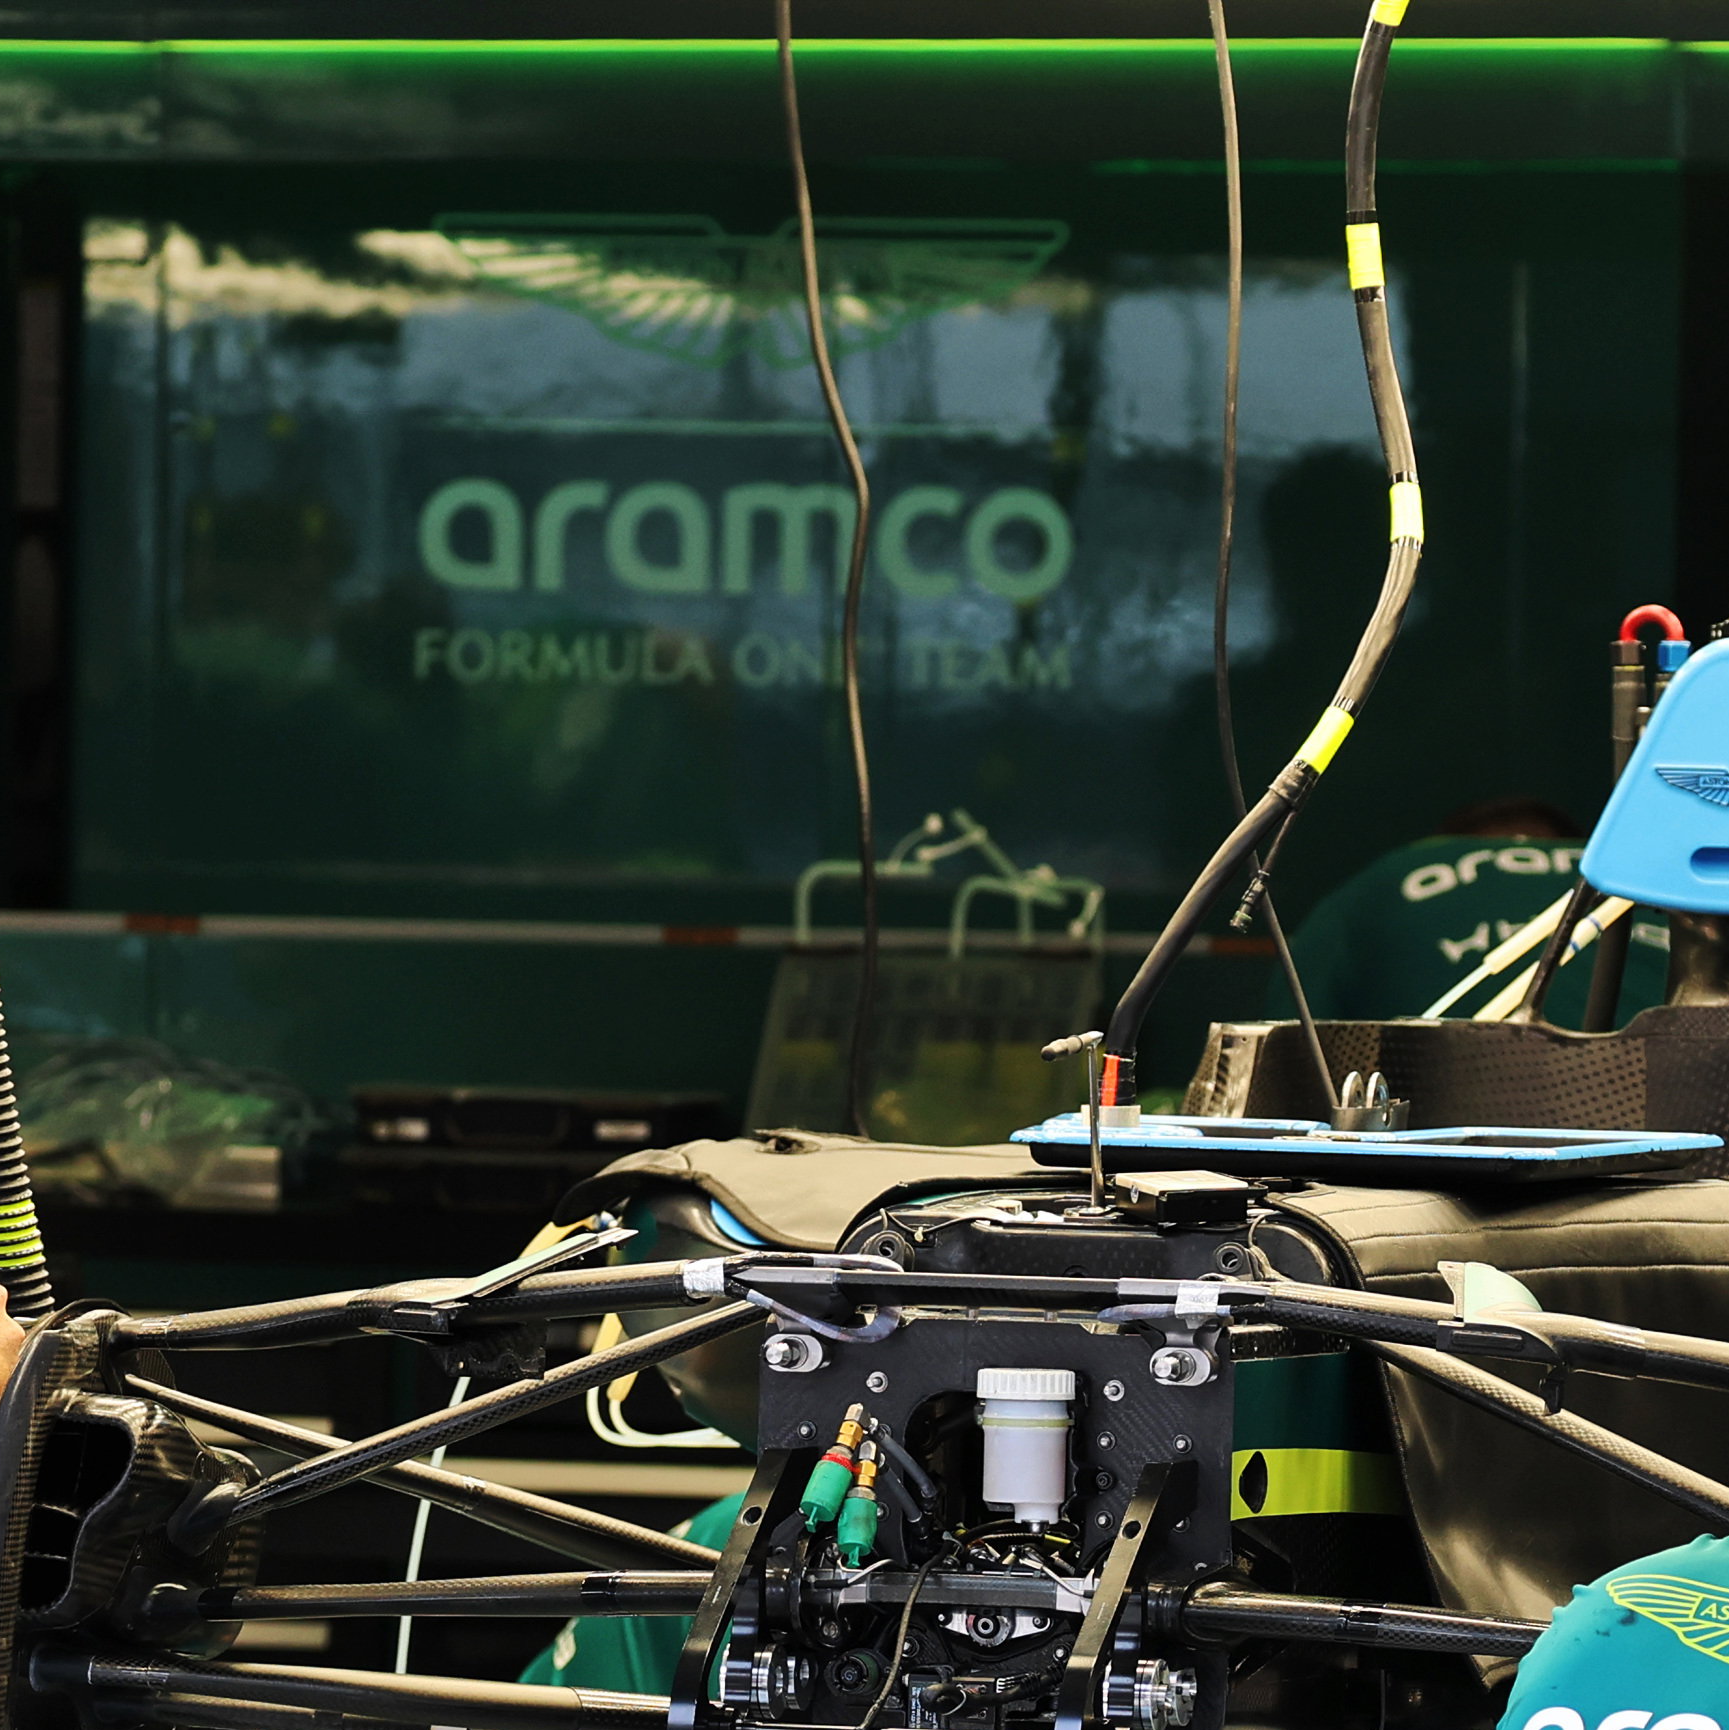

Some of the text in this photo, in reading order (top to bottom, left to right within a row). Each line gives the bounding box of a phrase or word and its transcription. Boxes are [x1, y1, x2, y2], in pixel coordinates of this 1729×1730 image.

[418, 478, 1071, 601] aramco
[412, 624, 716, 686] FORMULA
[907, 636, 1072, 690] TEAM
[1401, 847, 1582, 900] ara
